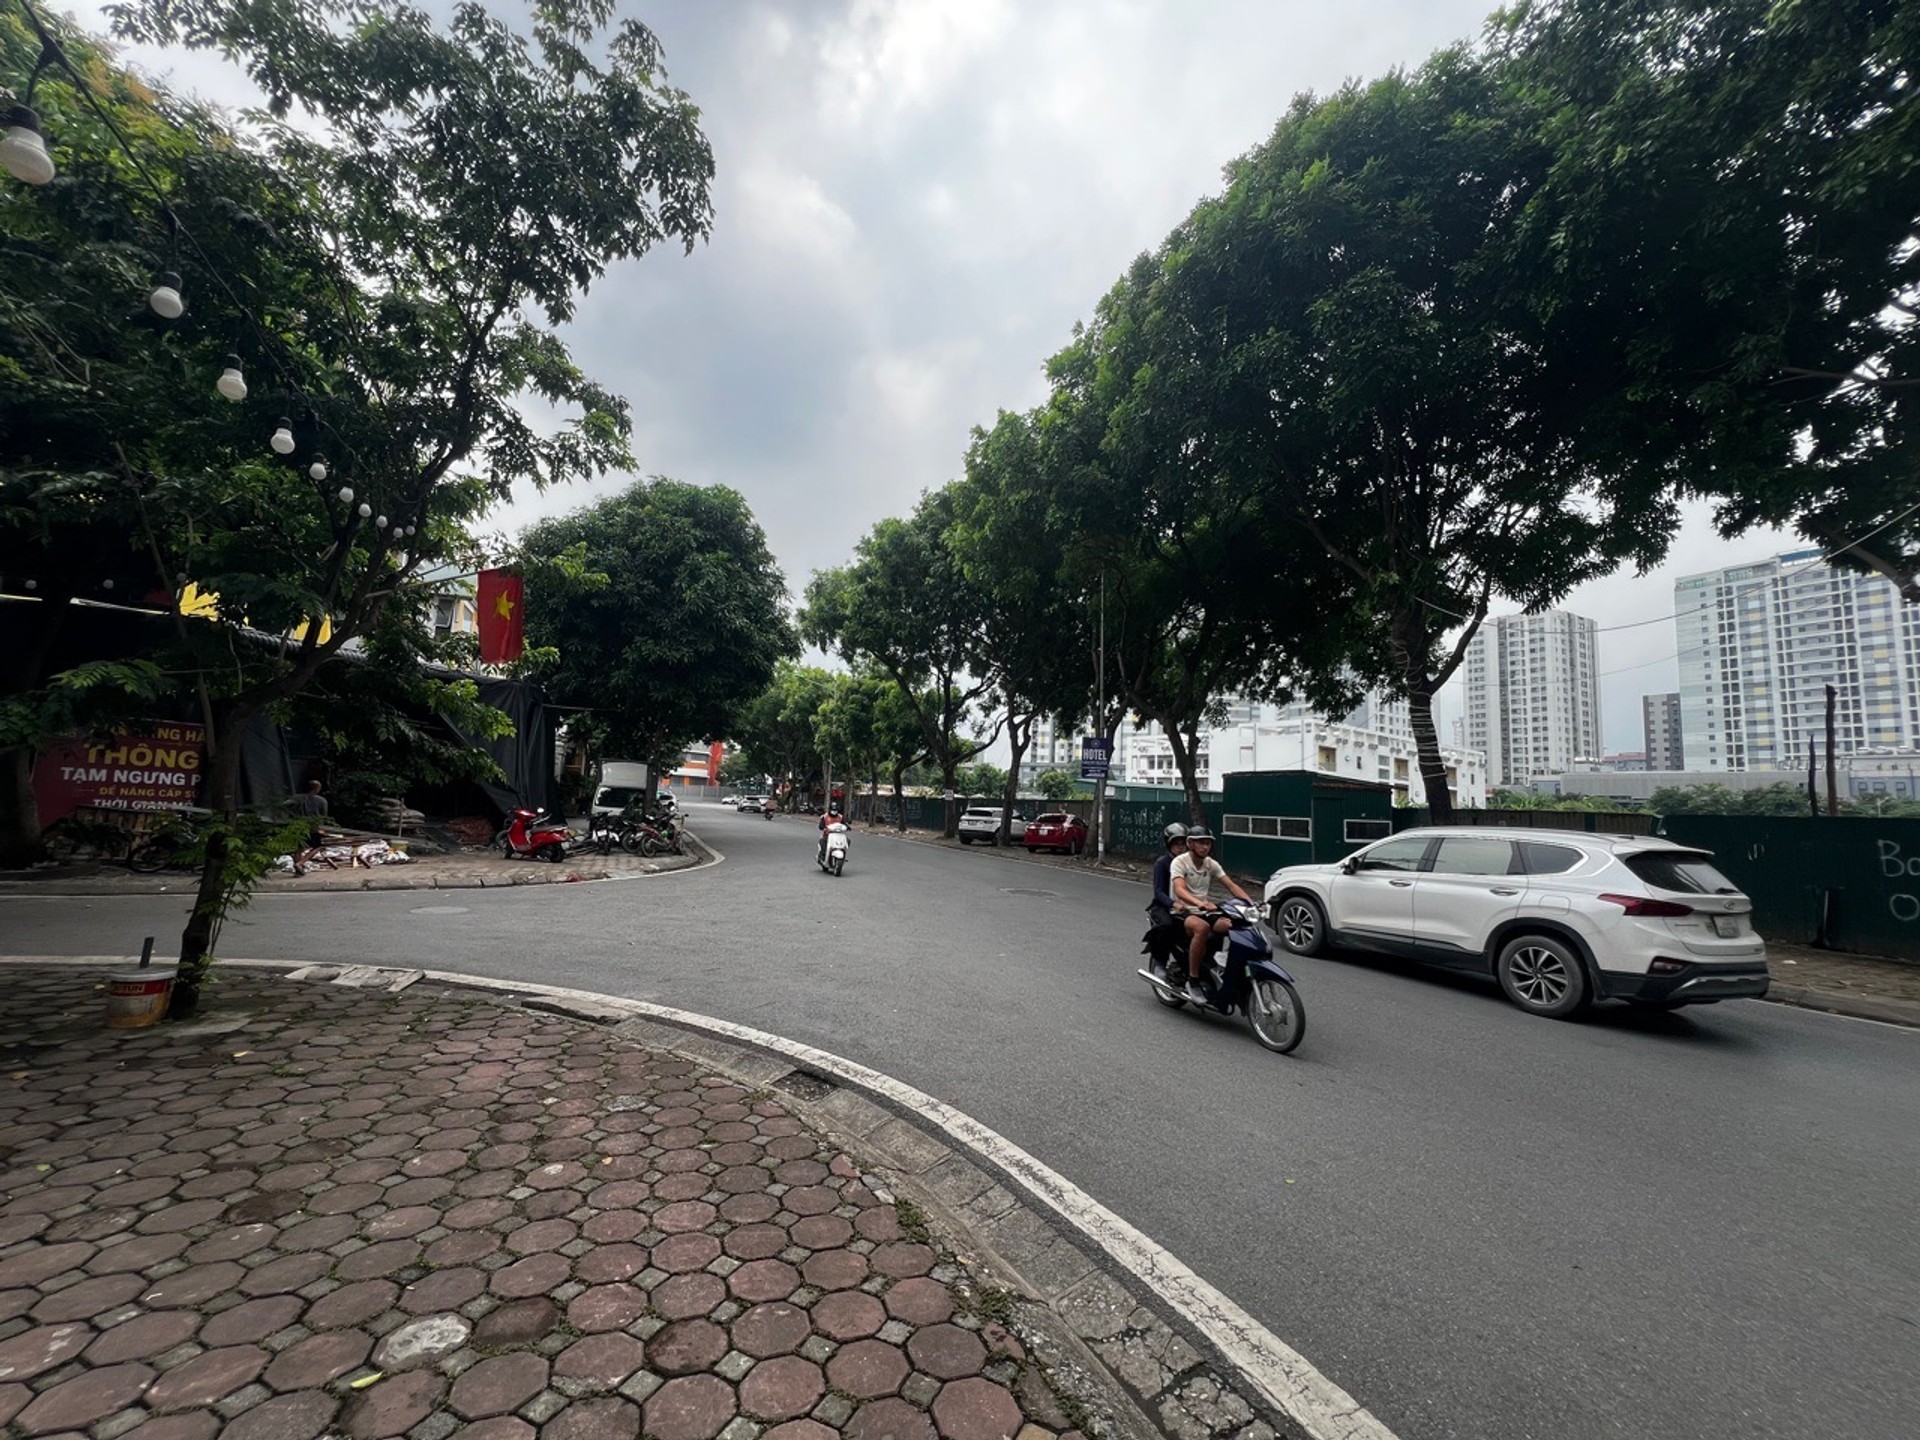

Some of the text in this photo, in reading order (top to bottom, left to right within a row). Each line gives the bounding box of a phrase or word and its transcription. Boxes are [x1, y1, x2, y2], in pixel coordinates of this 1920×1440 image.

[83, 743, 200, 769] THÔNG
[1082, 748, 1107, 760] HOTEL
[60, 766, 107, 784] TẠM
[113, 769, 186, 785] NGƯNG
